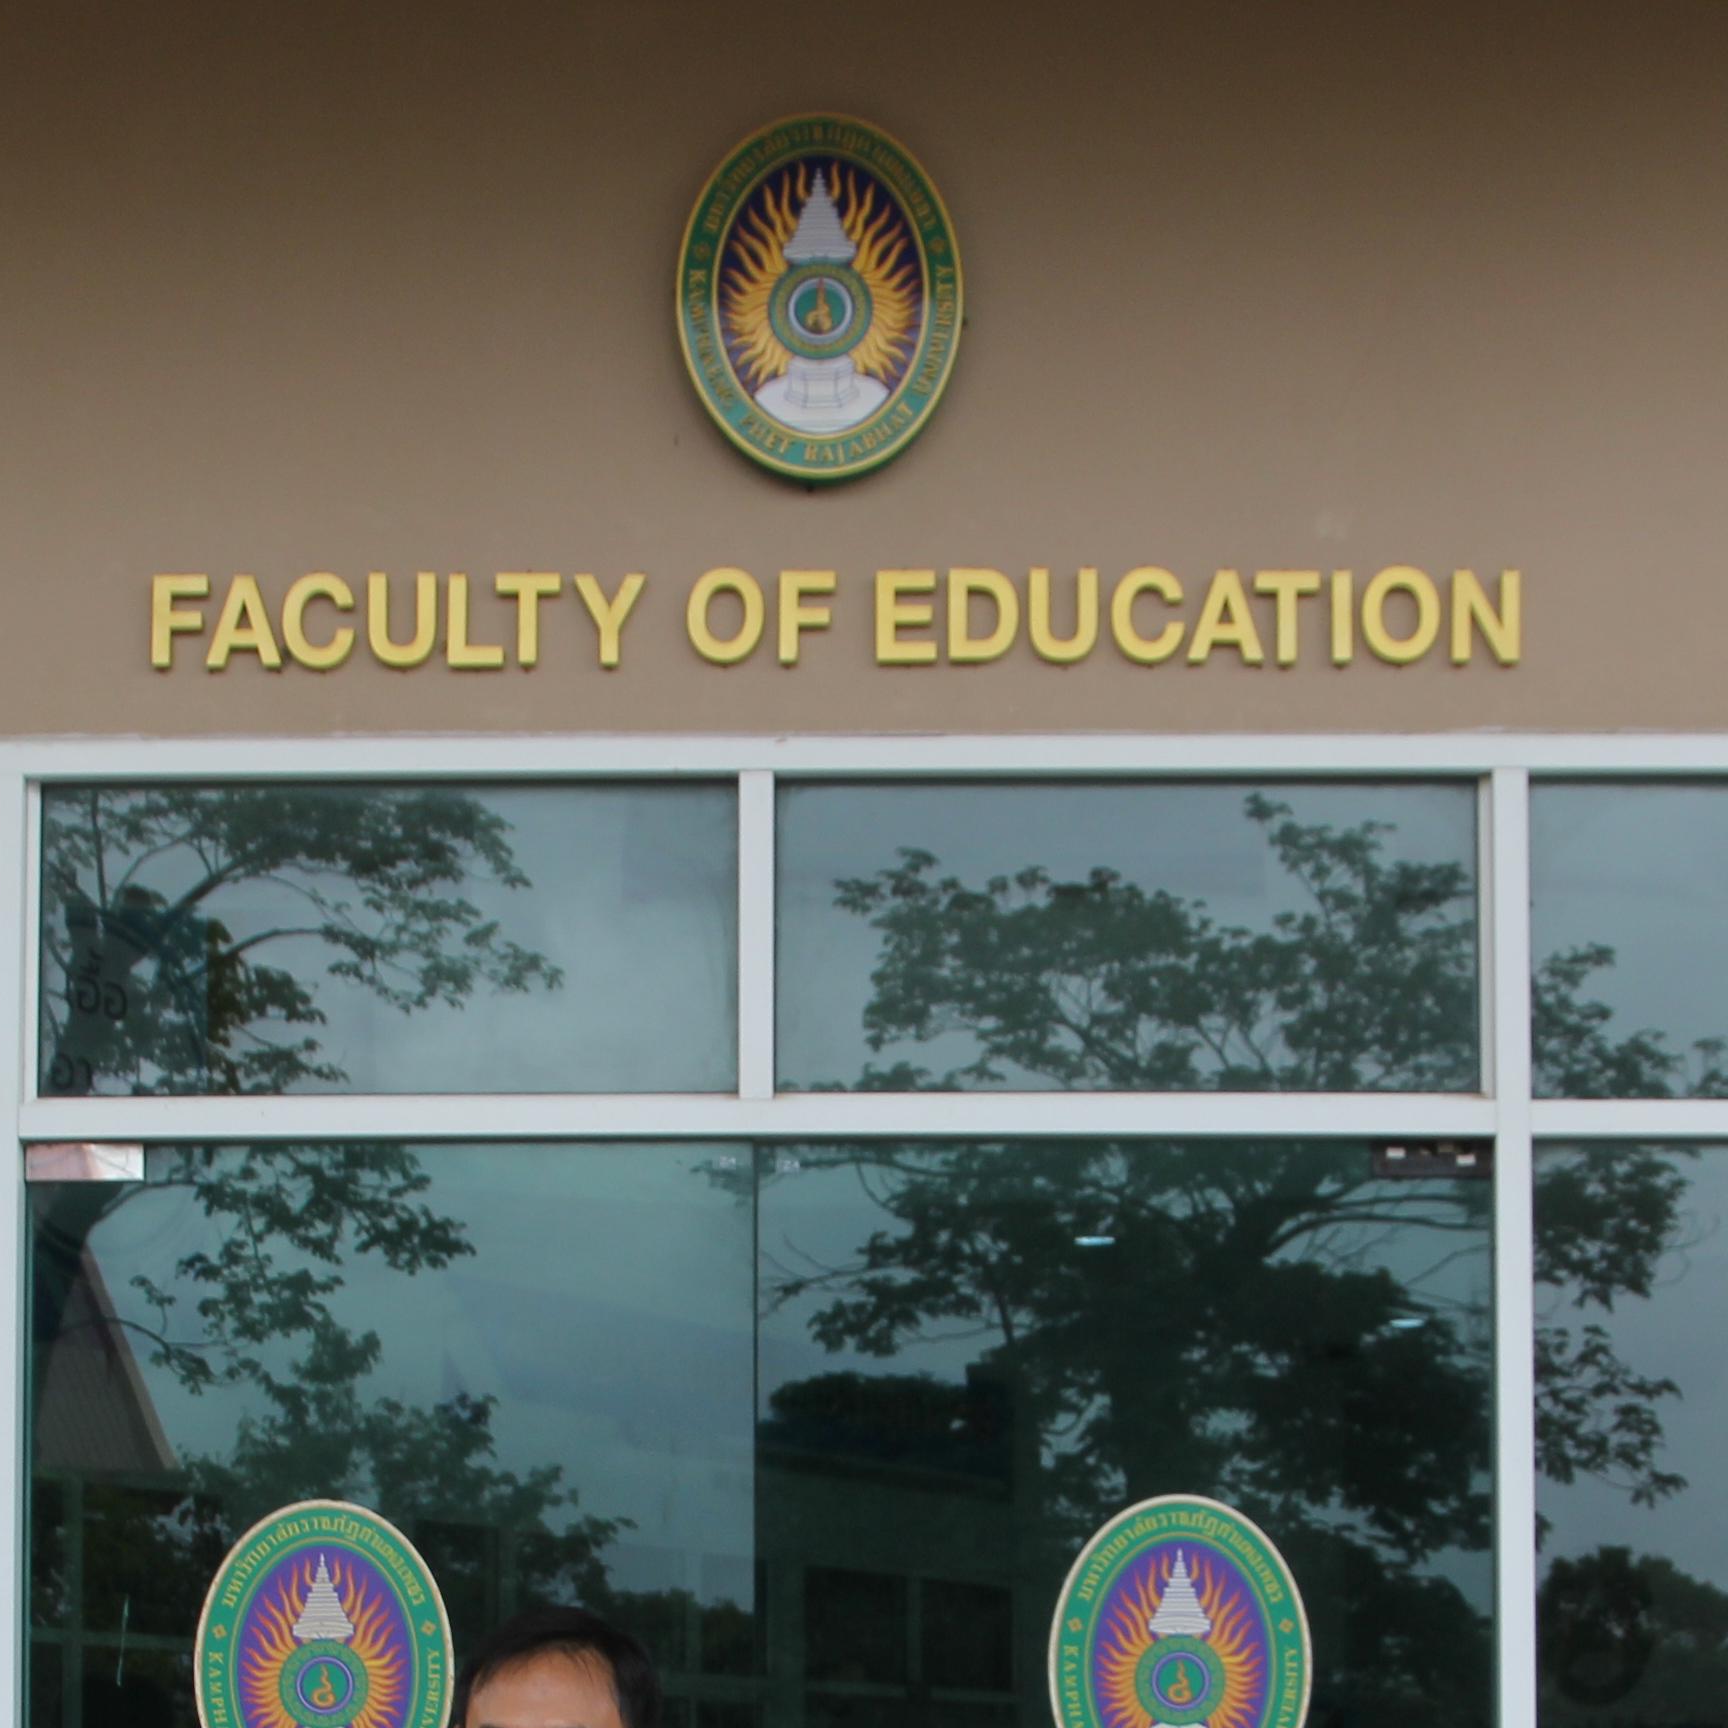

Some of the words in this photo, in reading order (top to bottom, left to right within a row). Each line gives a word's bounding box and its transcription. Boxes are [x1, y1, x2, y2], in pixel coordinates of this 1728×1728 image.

[151, 572, 646, 669] FACULTY
[686, 566, 837, 668] OF
[875, 565, 1521, 665] EDUCATION
